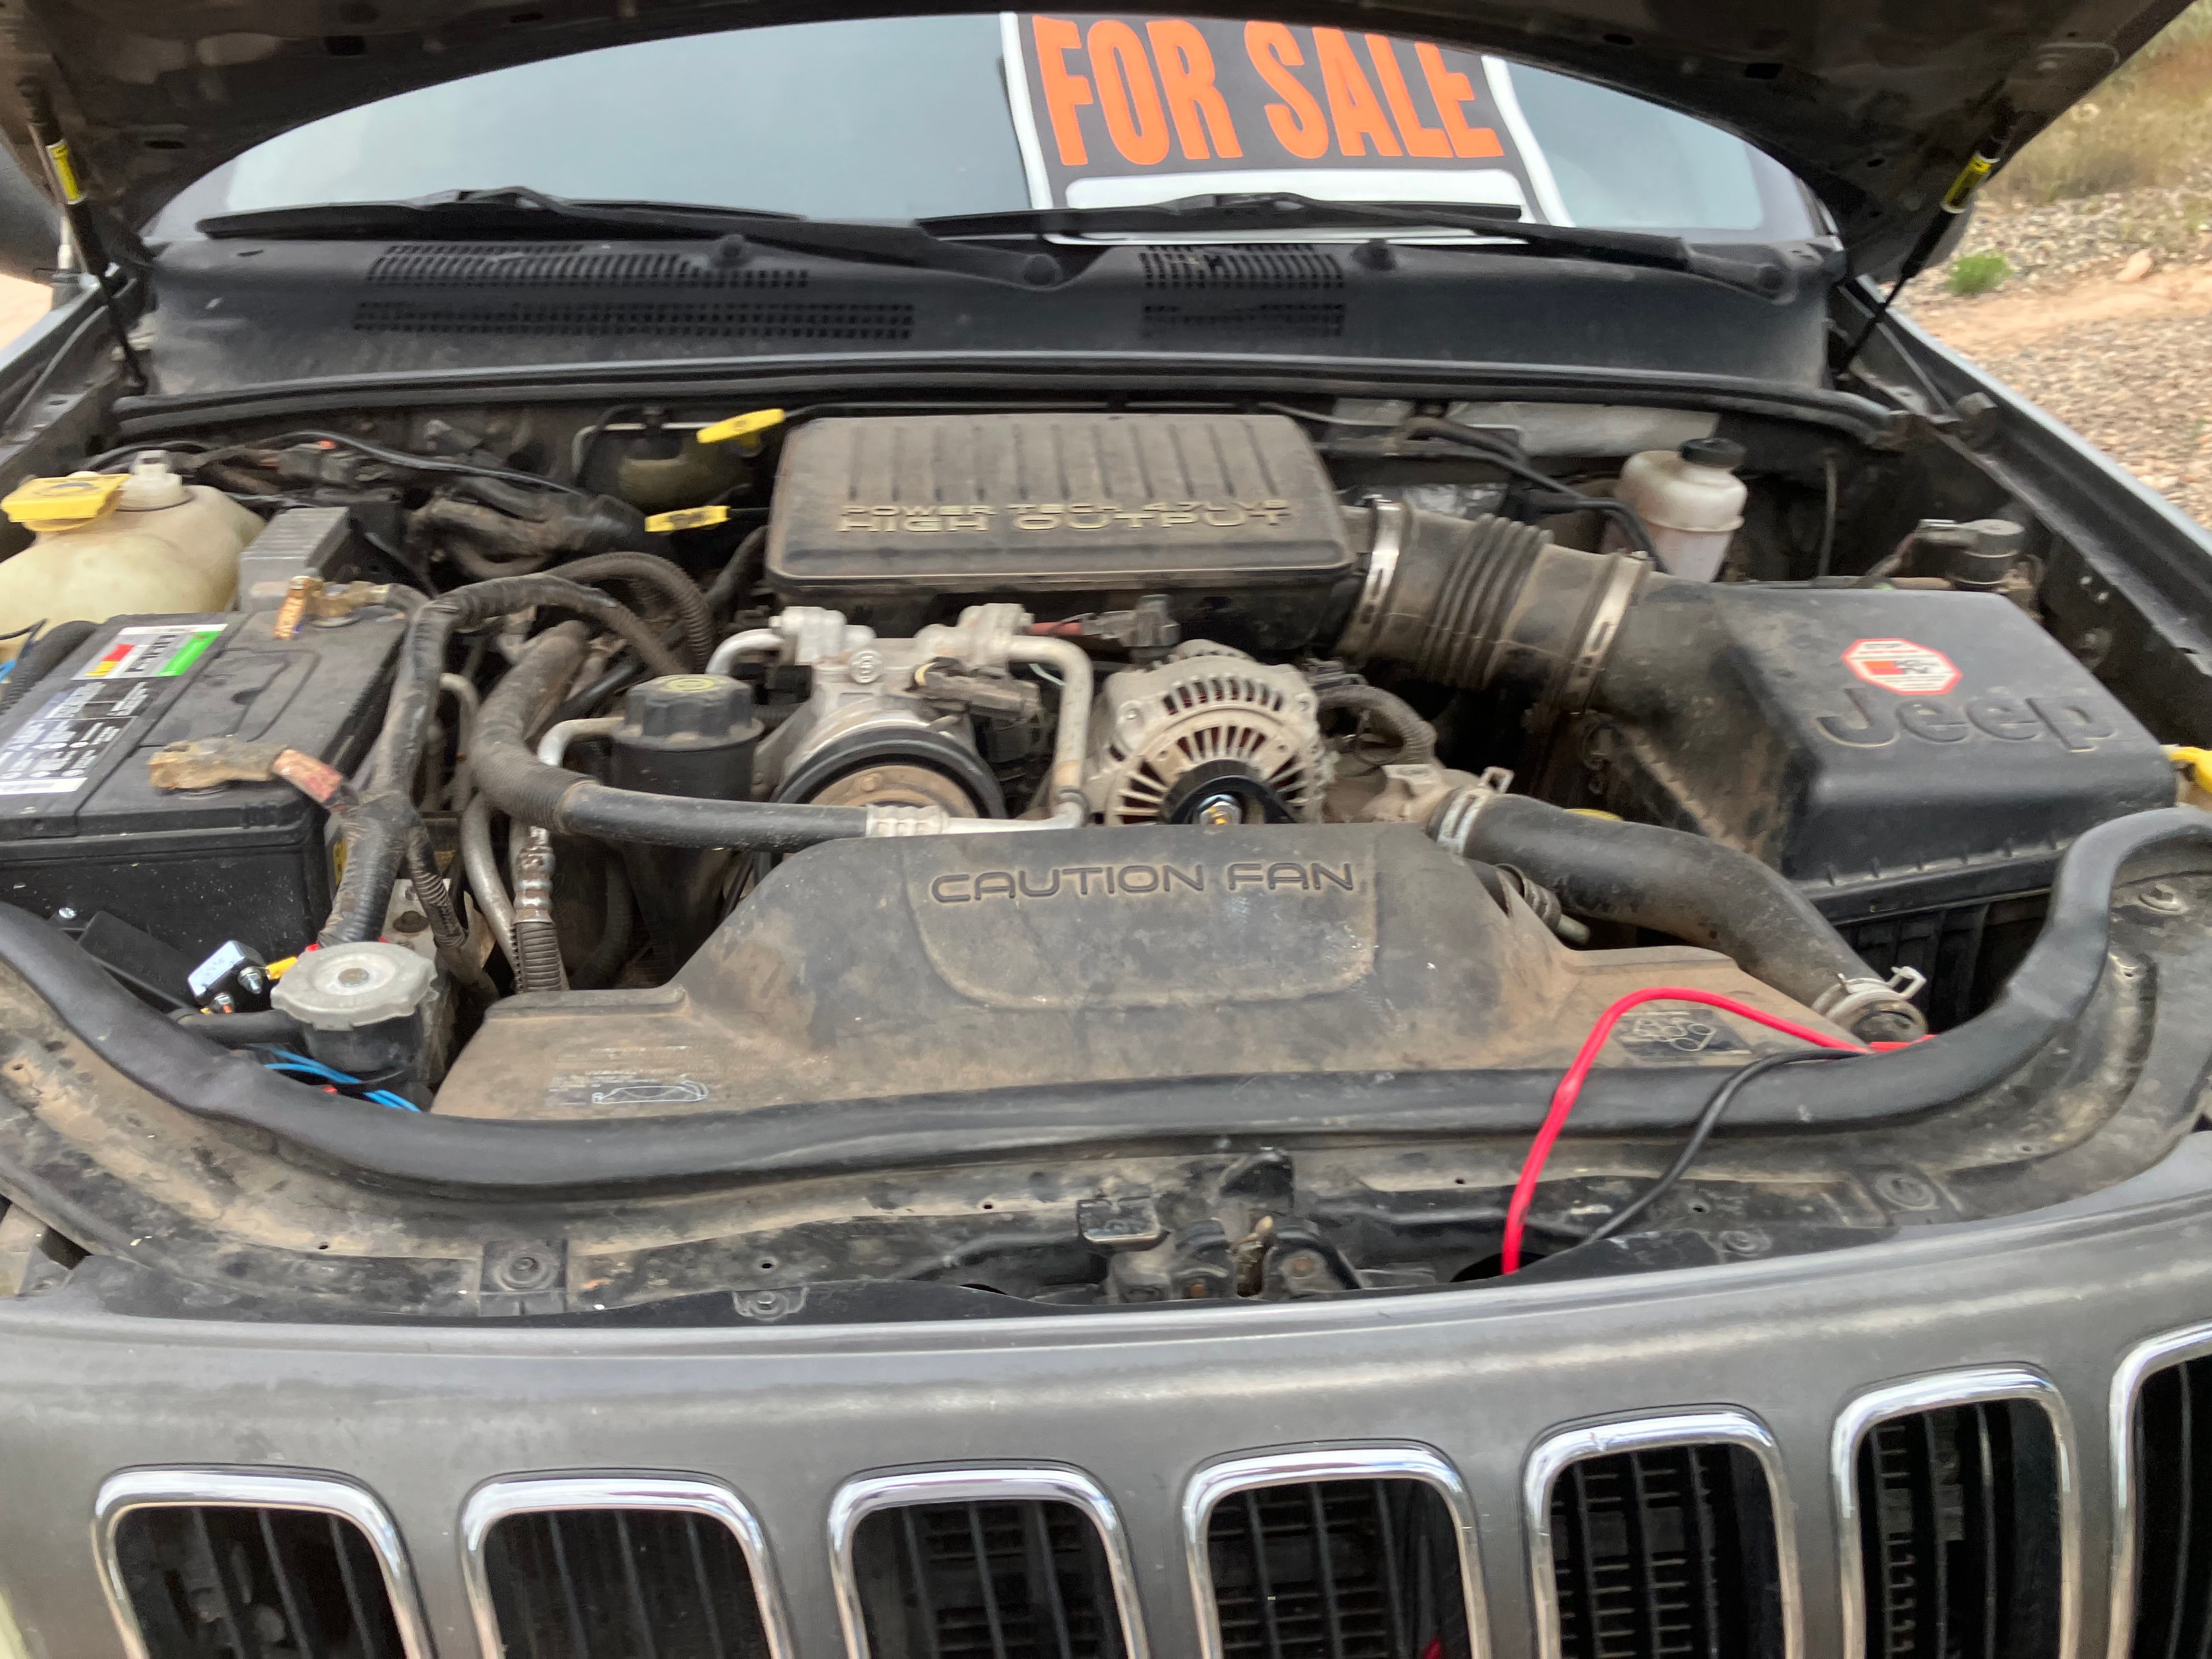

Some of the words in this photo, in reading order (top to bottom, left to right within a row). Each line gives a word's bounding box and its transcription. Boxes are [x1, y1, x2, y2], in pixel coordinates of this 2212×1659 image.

[1033, 15, 1243, 166] FOR
[1244, 20, 1504, 159] SALE
[835, 516, 989, 532] HIGH
[1013, 511, 1291, 532] OUTPUT
[839, 504, 996, 517] POWER
[1005, 501, 1124, 515] TECH
[1813, 687, 2119, 753] Jeep
[930, 863, 1205, 903] CAUTION
[1226, 862, 1355, 891] FAN
